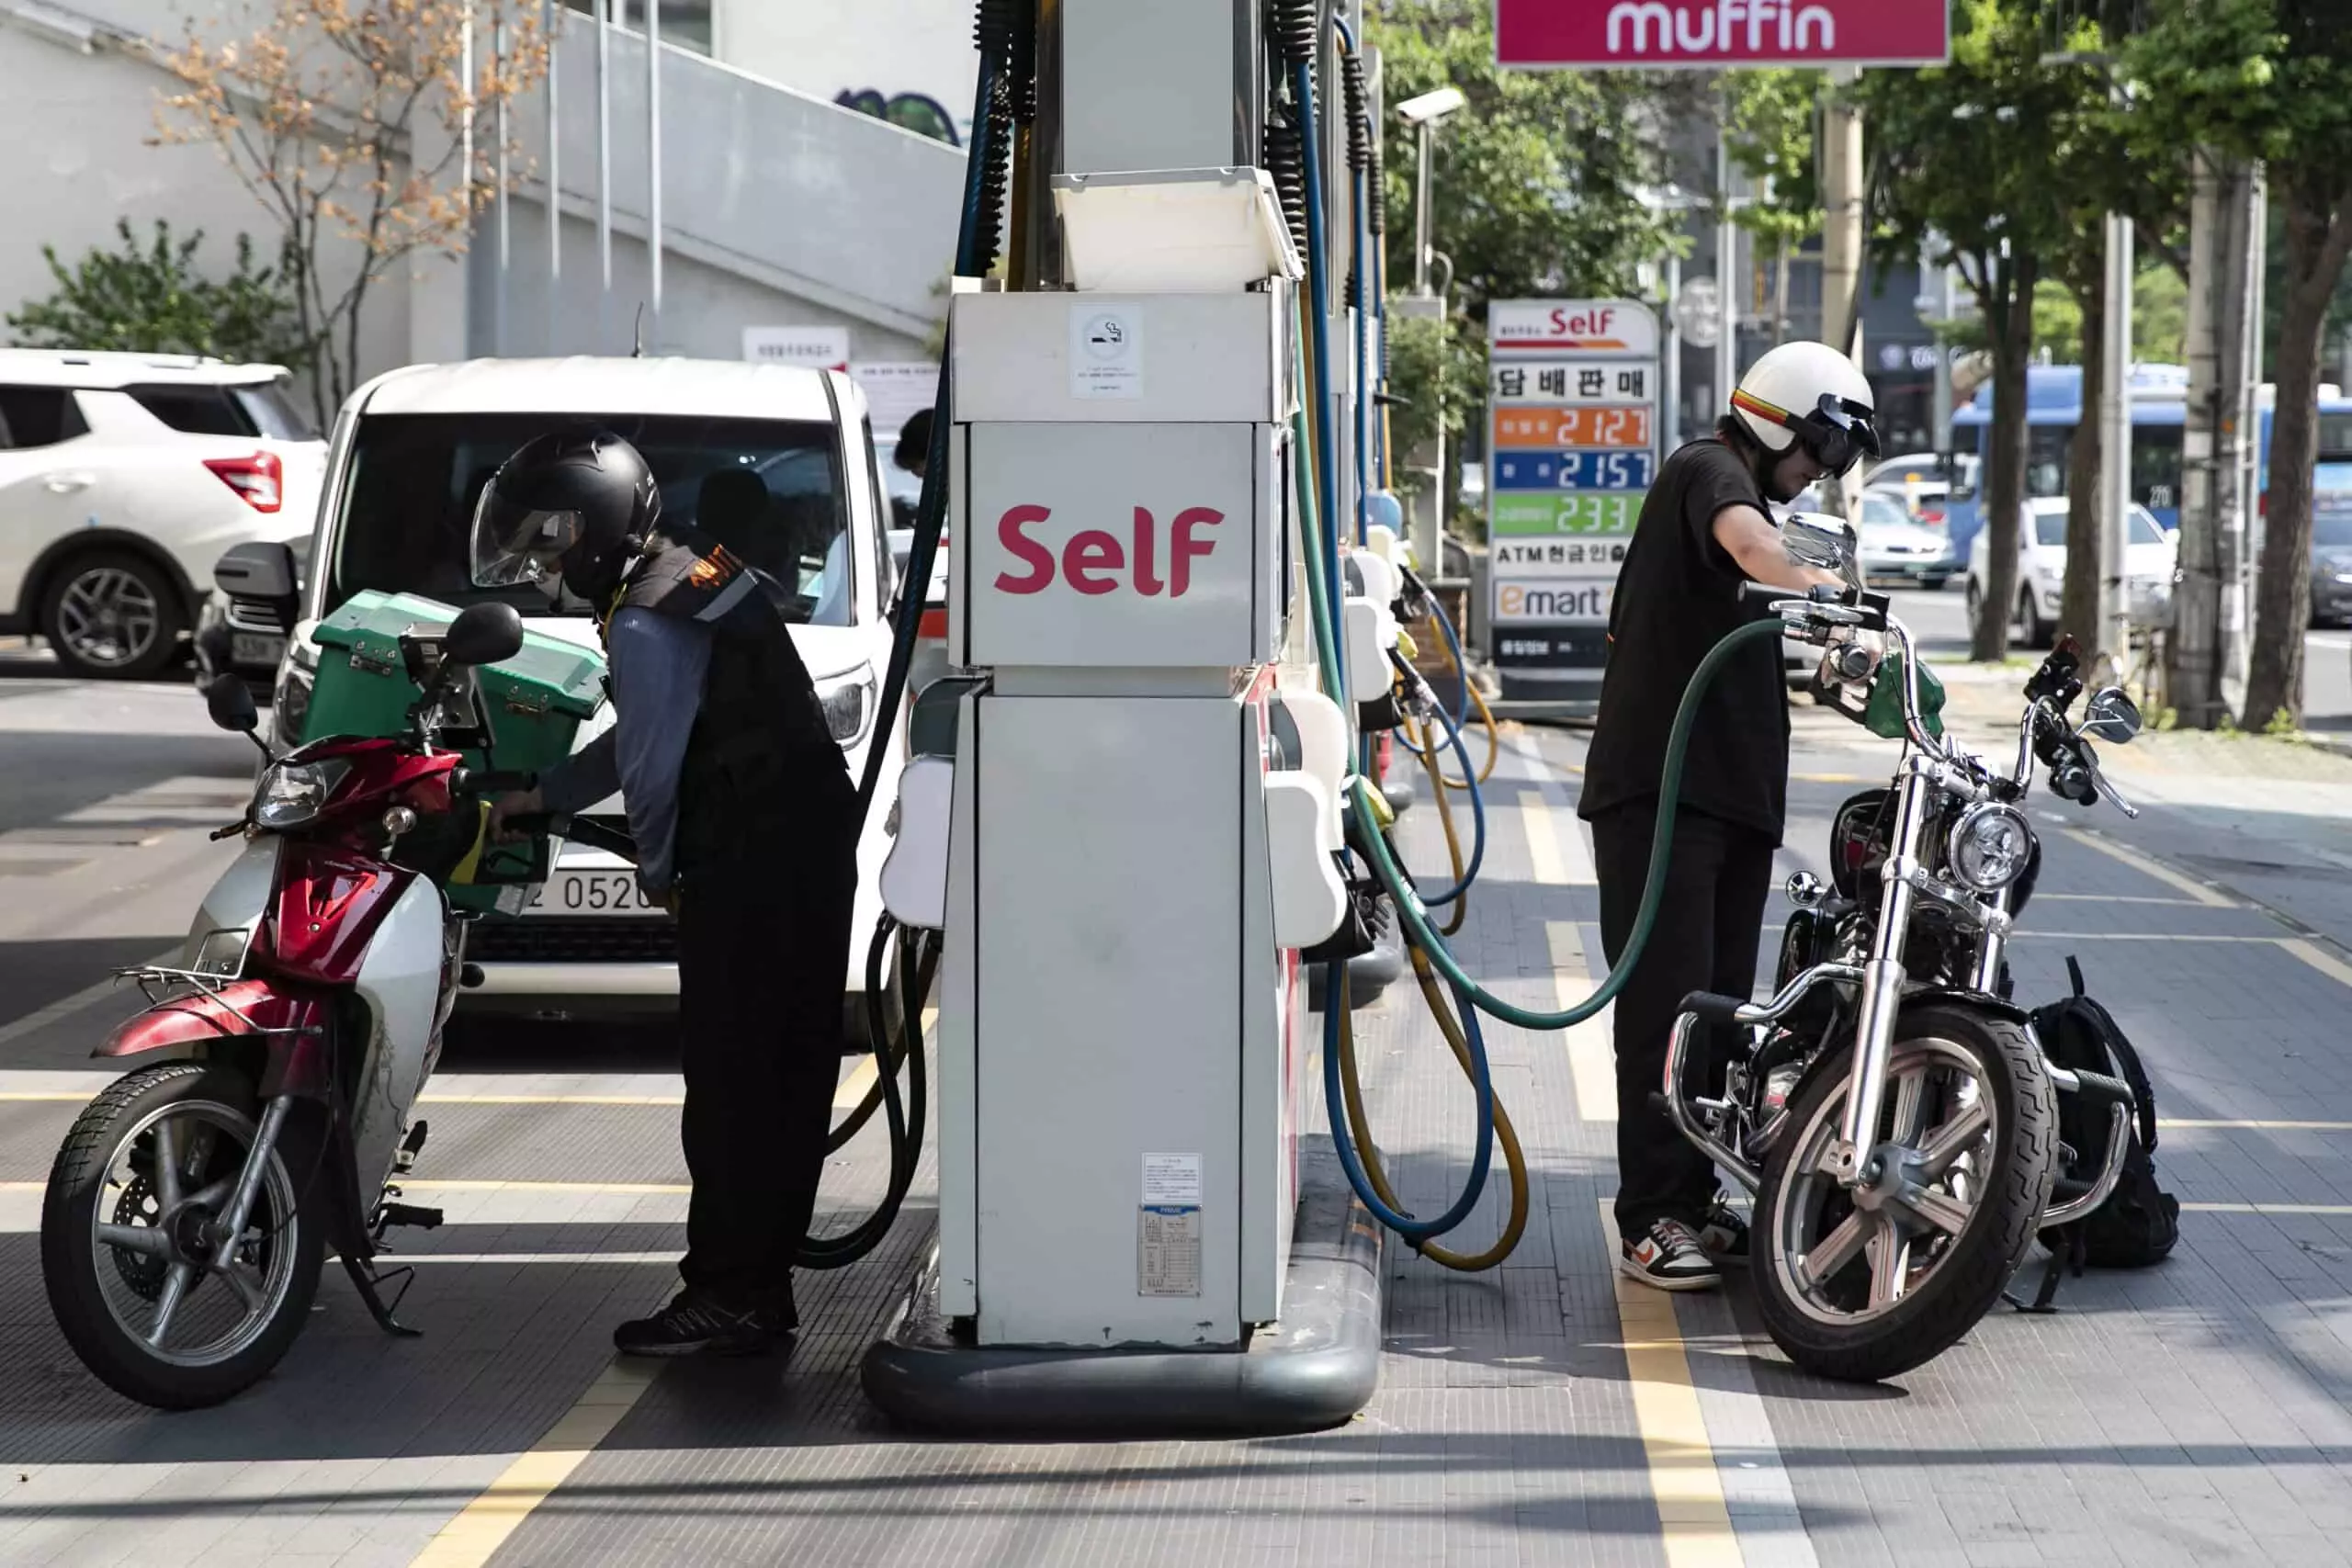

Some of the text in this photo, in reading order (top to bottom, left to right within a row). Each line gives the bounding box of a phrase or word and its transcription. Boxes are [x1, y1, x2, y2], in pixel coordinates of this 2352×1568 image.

[1607, 0, 1835, 52] muffin
[1549, 308, 1615, 336] Self
[1556, 410, 1646, 446] 2127
[1558, 453, 1652, 488] 2157
[1557, 497, 1646, 532] 233
[993, 503, 1226, 598] Self
[1497, 547, 1543, 563] ATM
[1499, 585, 1614, 615] emart
